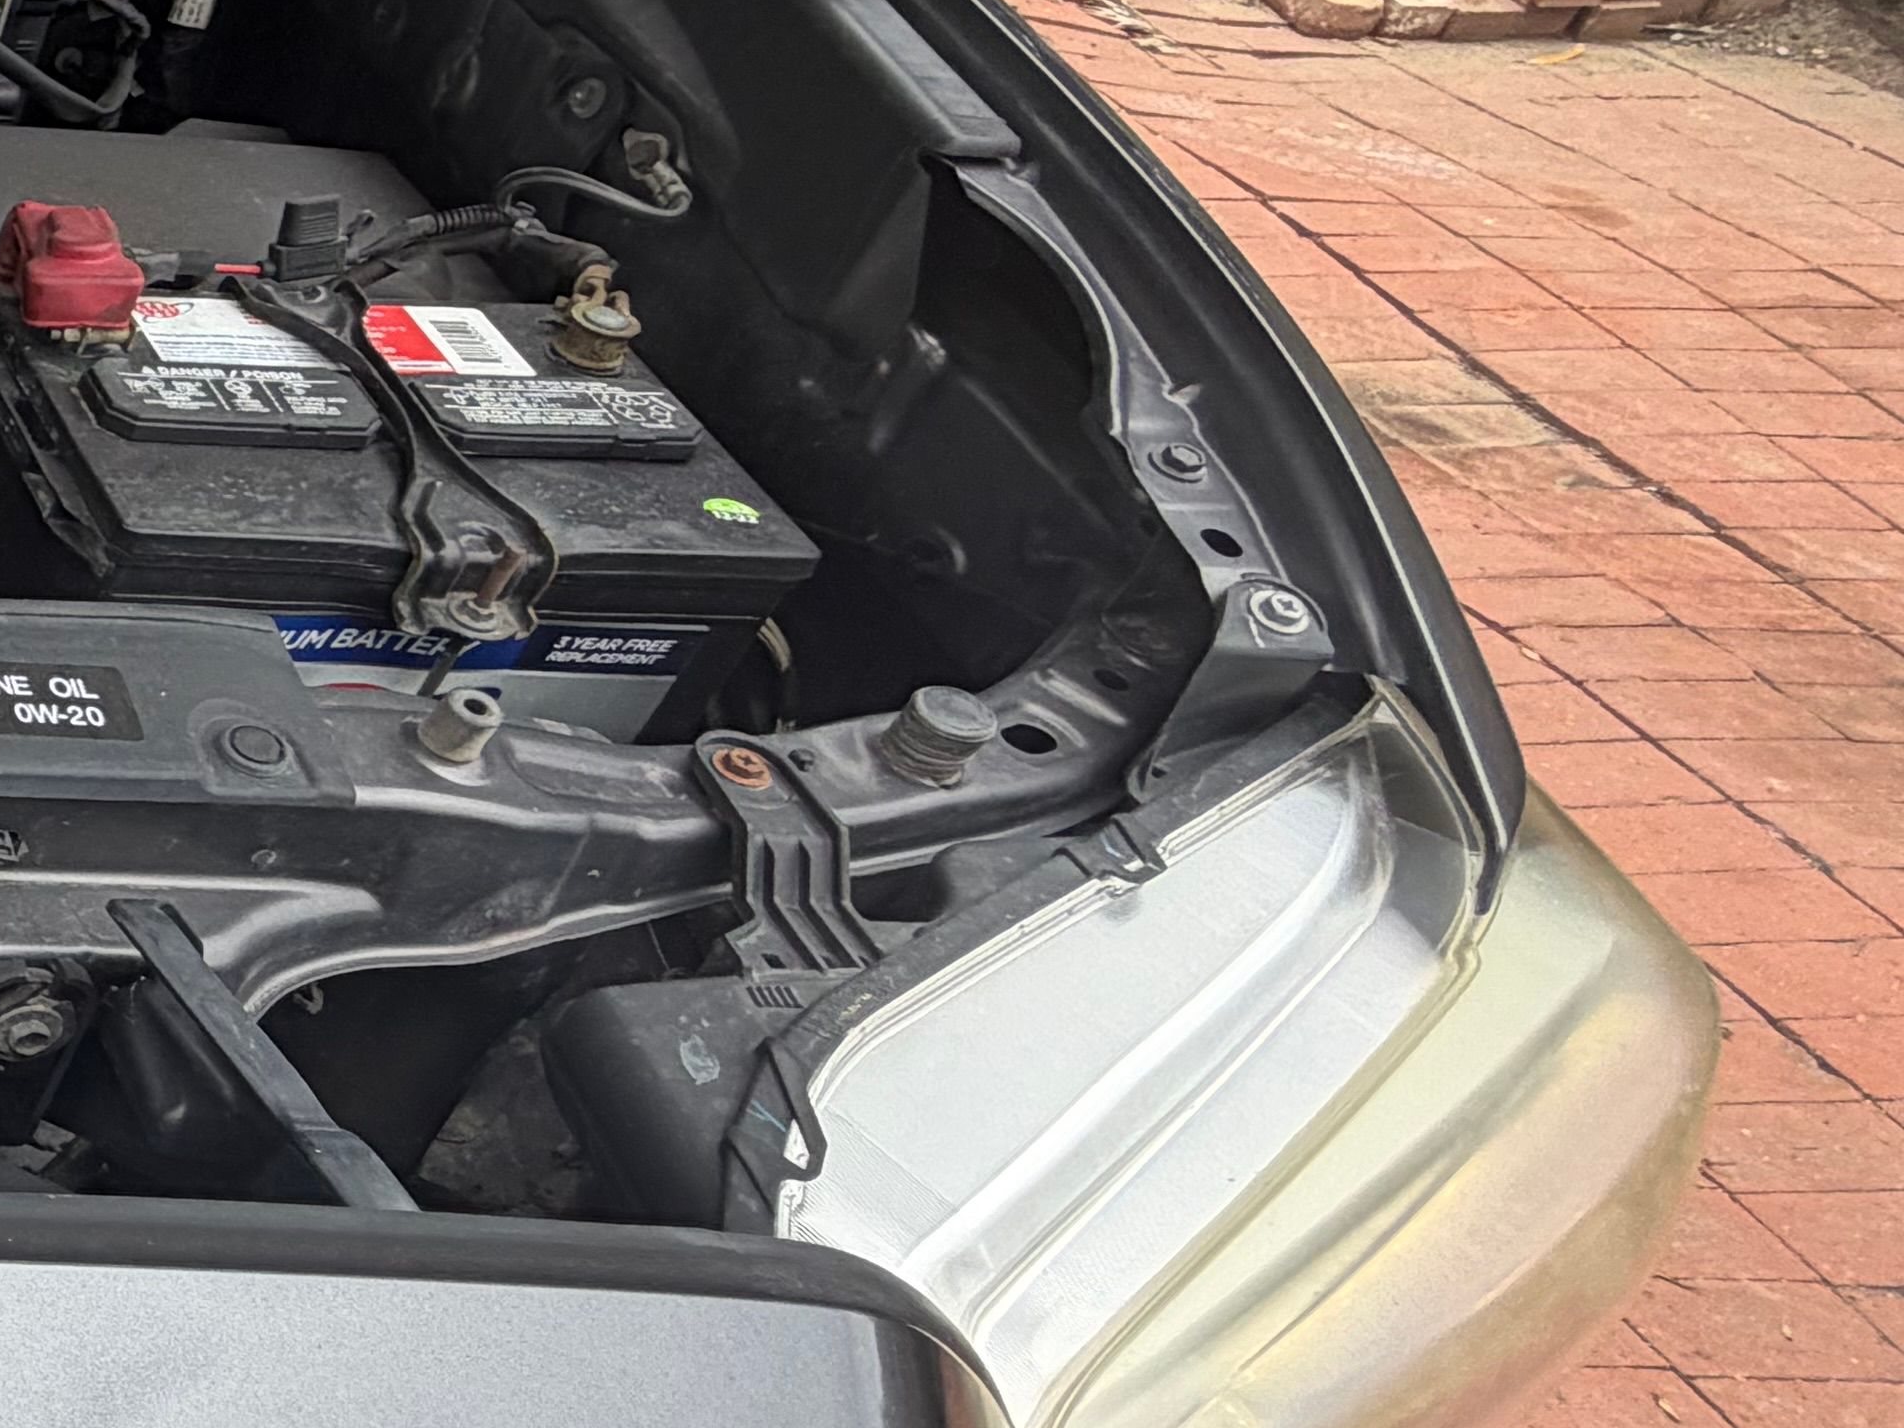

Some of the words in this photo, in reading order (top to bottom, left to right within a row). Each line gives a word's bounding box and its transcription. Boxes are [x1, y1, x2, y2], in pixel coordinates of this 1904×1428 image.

[553, 635, 572, 650] 3
[571, 637, 624, 651] YEAR
[621, 638, 679, 653] FREE
[544, 651, 667, 665] REPLACEMENT
[48, 676, 100, 700] OIL
[14, 703, 105, 727] 0W-20
